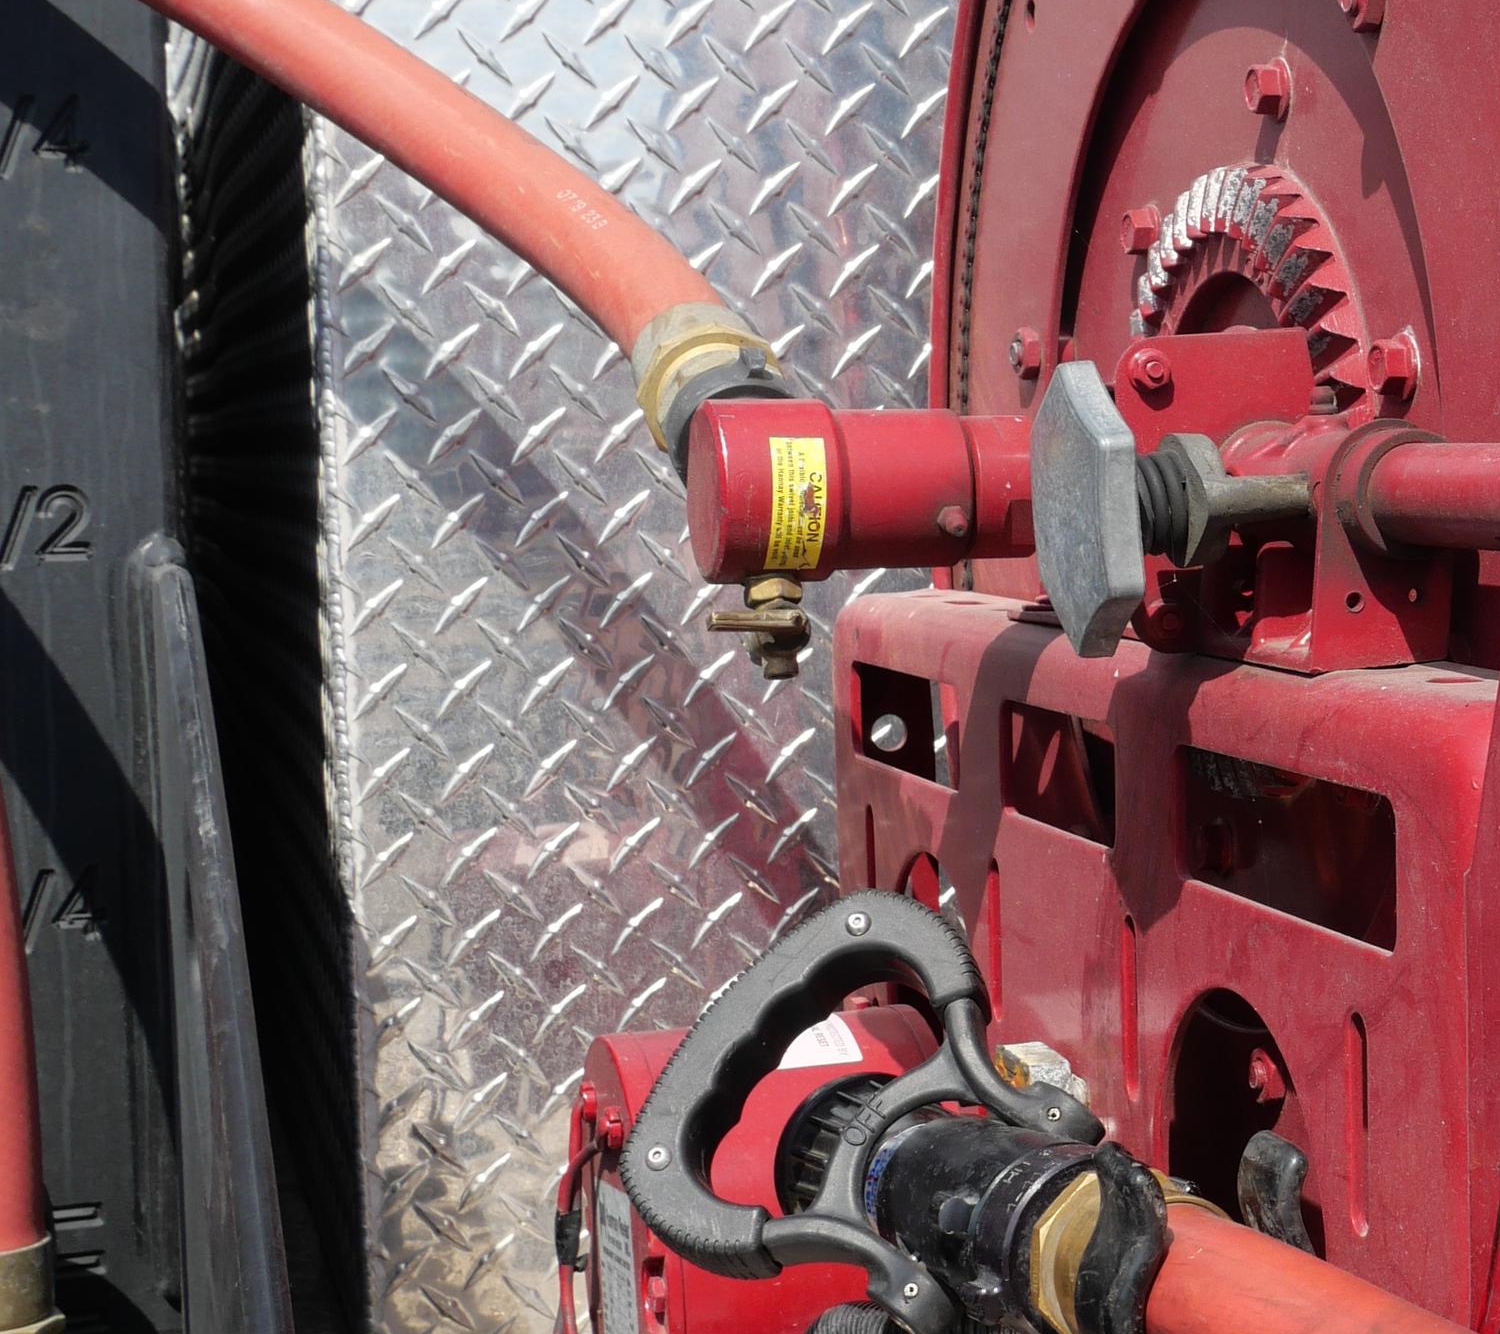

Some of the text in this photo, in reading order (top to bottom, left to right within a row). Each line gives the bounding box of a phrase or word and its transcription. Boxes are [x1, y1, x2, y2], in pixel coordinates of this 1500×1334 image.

[775, 468, 785, 493] Hannay
[775, 495, 786, 526] Warranty
[843, 1092, 887, 1147] OFF
